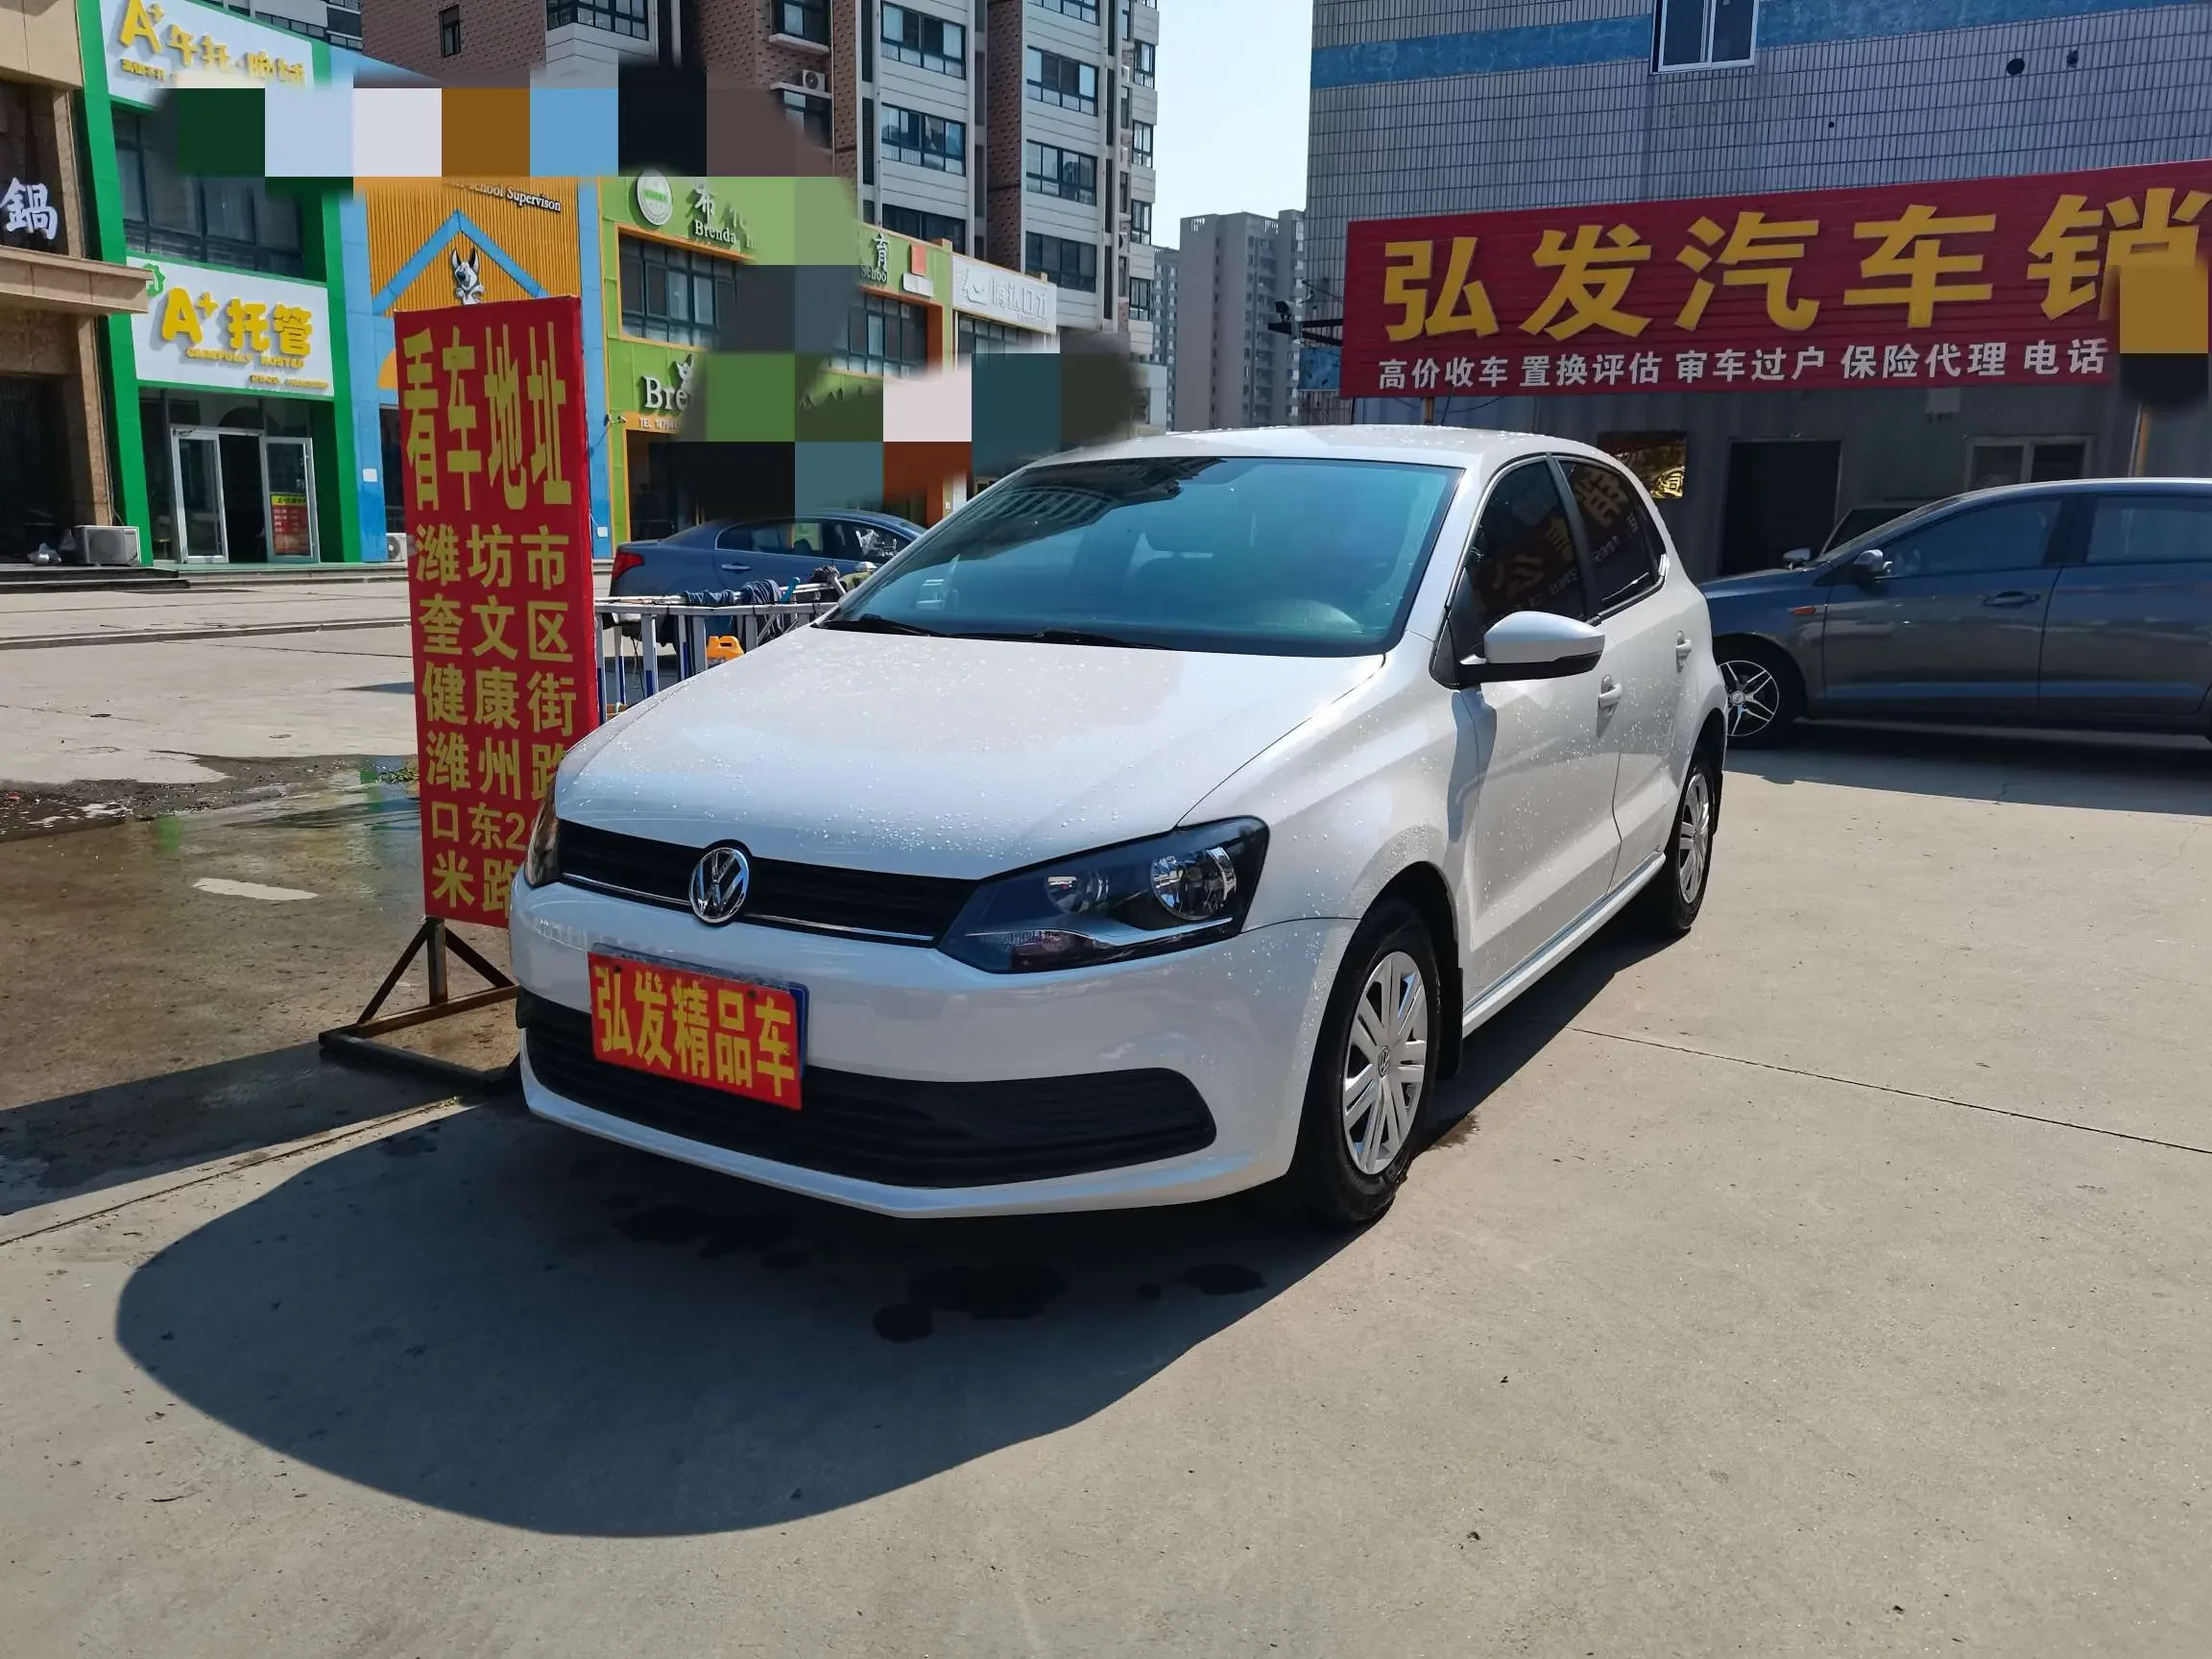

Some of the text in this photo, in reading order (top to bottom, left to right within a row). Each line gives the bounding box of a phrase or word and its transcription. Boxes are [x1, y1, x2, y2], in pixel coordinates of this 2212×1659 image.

[694, 219, 737, 244] Brenda
[1379, 337, 2108, 390] 高价收车 置换评估 审车过户 保险代理 电话
[402, 321, 572, 512] 看车地址
[415, 523, 569, 590] 潍坊市
[418, 592, 573, 662] 奎文区
[421, 661, 577, 737] 健康街
[431, 802, 534, 851] 口东2
[594, 965, 795, 1096] 弘发精品车
